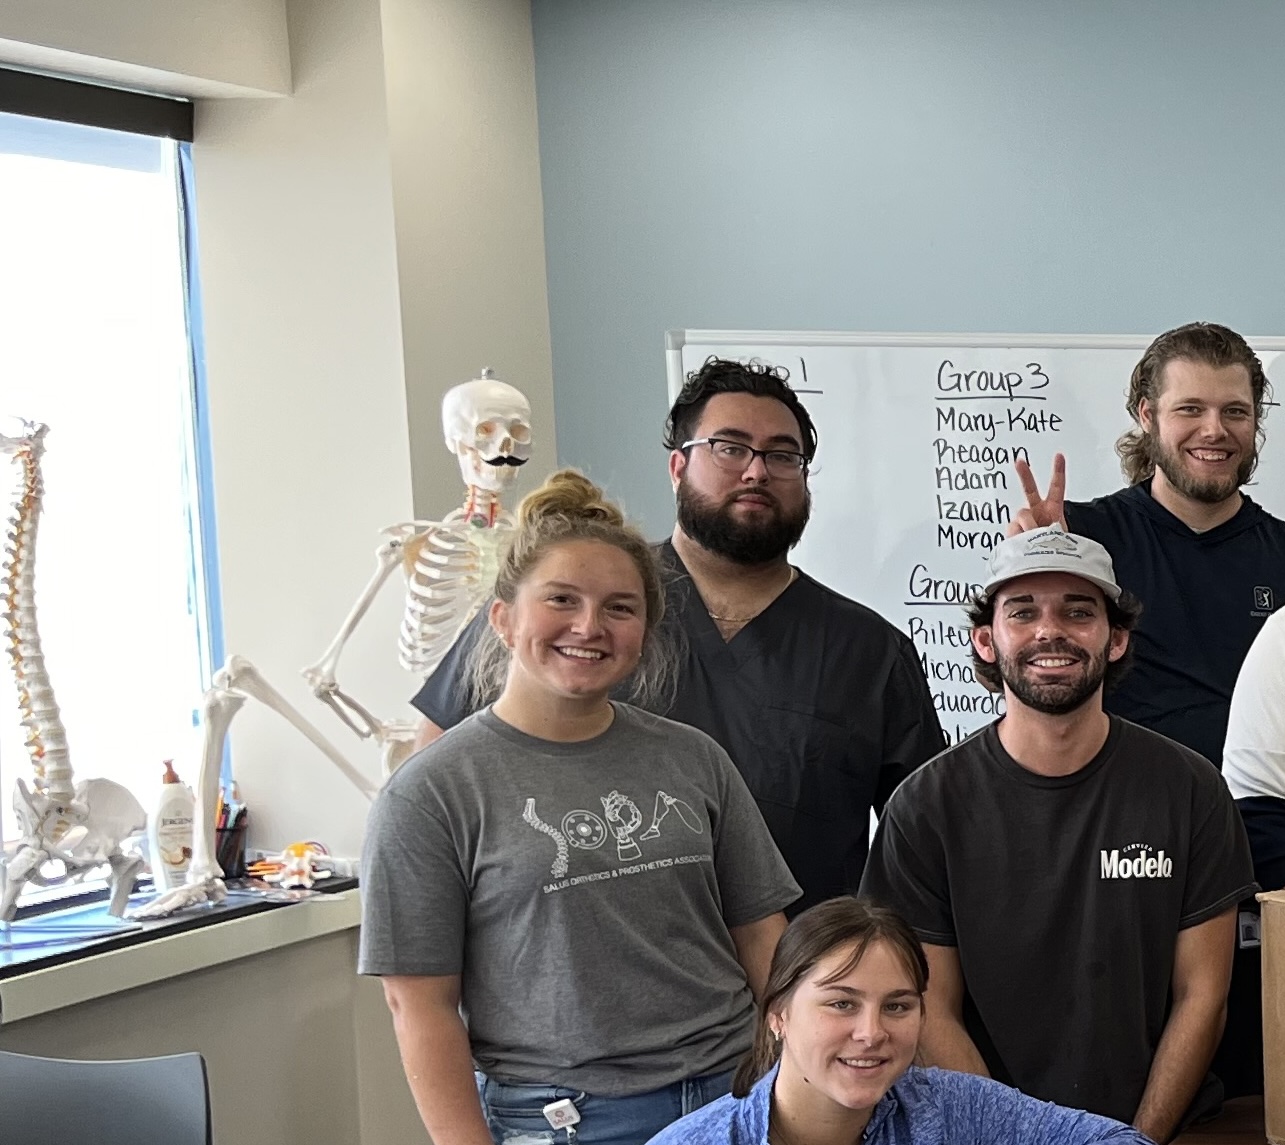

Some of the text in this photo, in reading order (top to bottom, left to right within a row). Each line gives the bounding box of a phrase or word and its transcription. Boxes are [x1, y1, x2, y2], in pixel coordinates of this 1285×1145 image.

[937, 360, 1050, 401] Group 3
[936, 407, 1063, 442] Mary-Kate
[933, 438, 1031, 471] Reagan
[936, 467, 1007, 490] Adam
[937, 494, 1010, 524] Izaiah
[543, 879, 570, 894] SALUS
[618, 858, 673, 876] PROSTHETICS
[1100, 850, 1173, 878] Modelo
